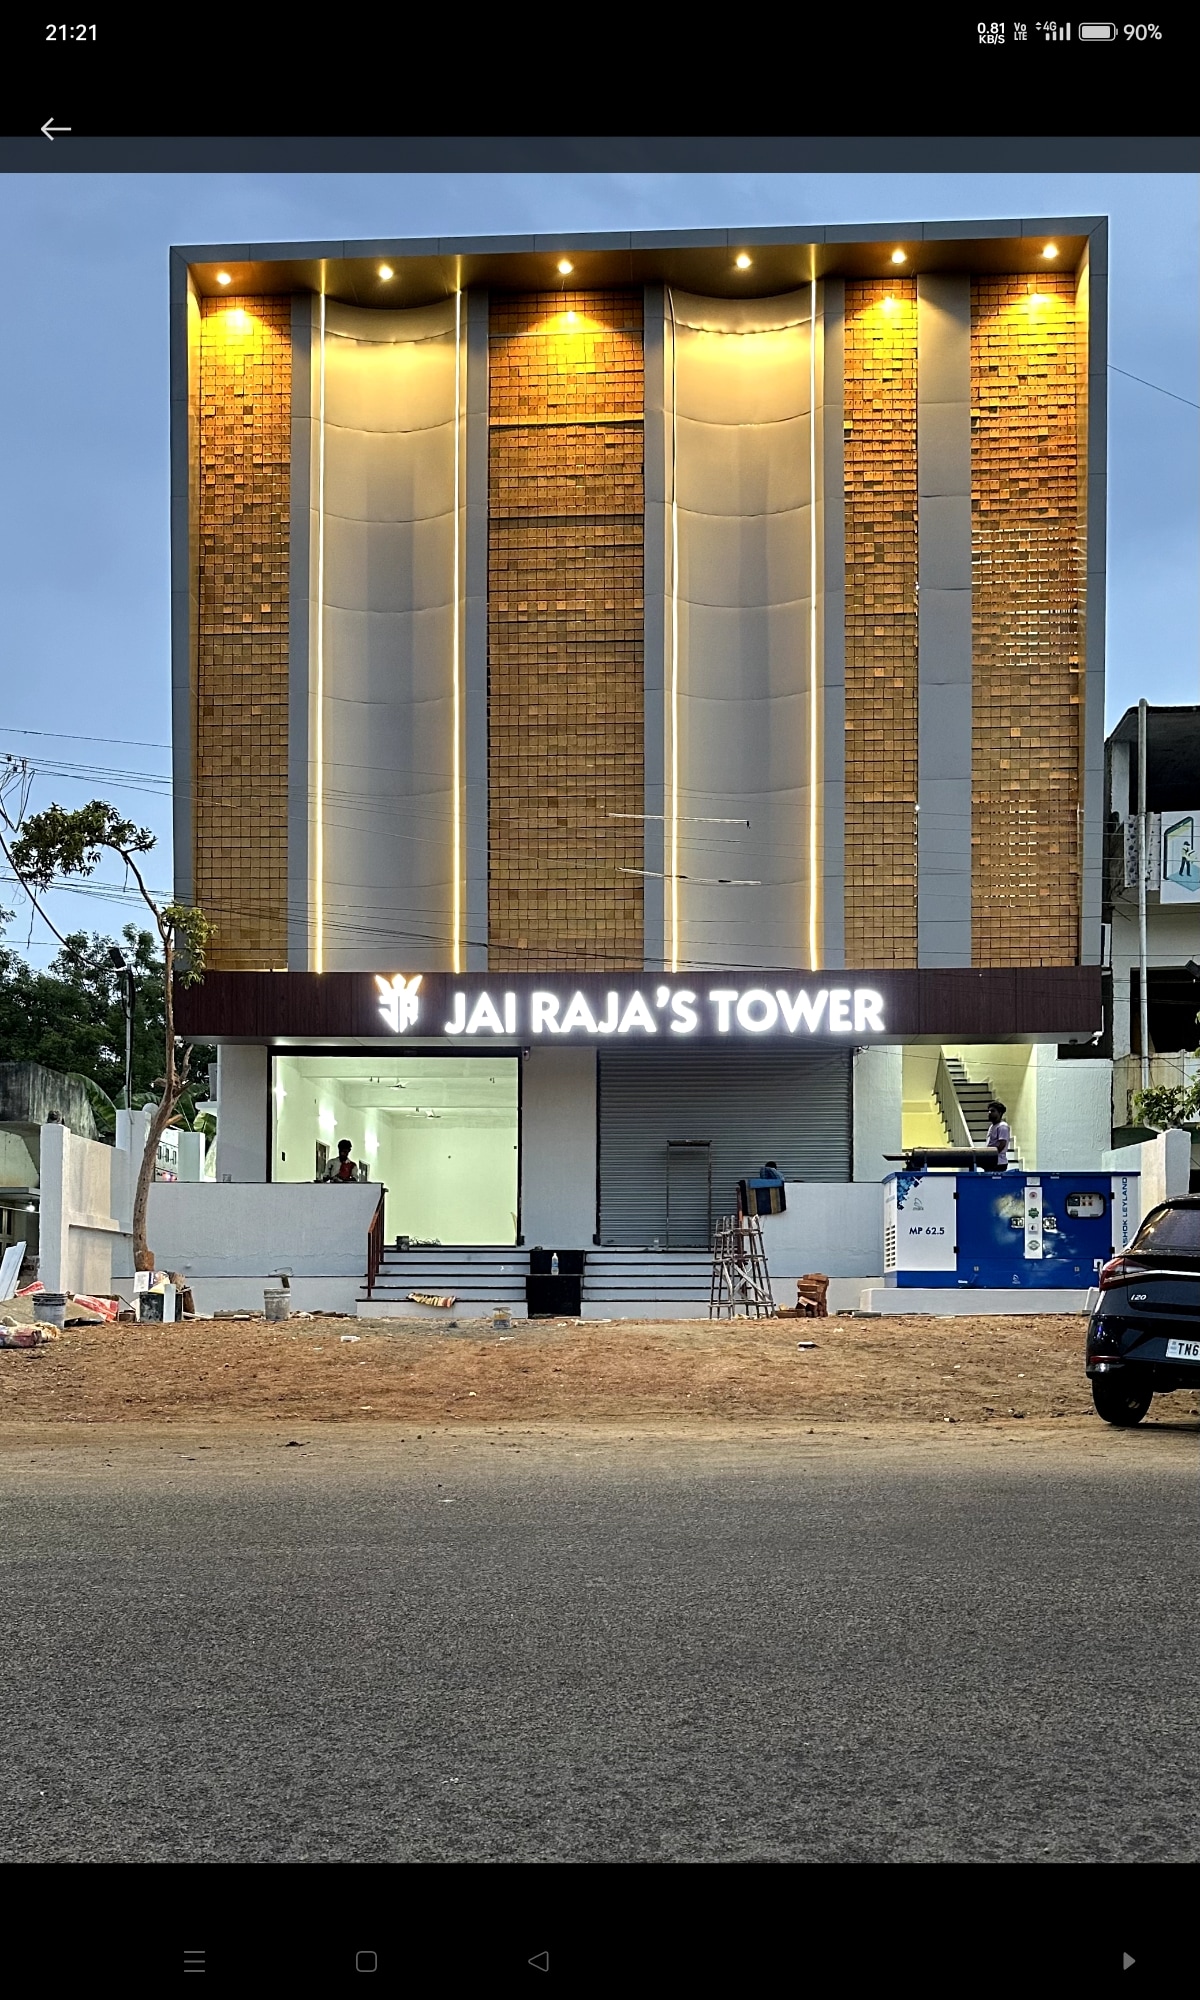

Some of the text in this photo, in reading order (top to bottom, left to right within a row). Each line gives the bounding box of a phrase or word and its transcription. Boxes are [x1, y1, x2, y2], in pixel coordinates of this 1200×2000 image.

[444, 985, 886, 1034] JAI RAJA'S TOWER
[909, 1226, 945, 1235] MP 62.5
